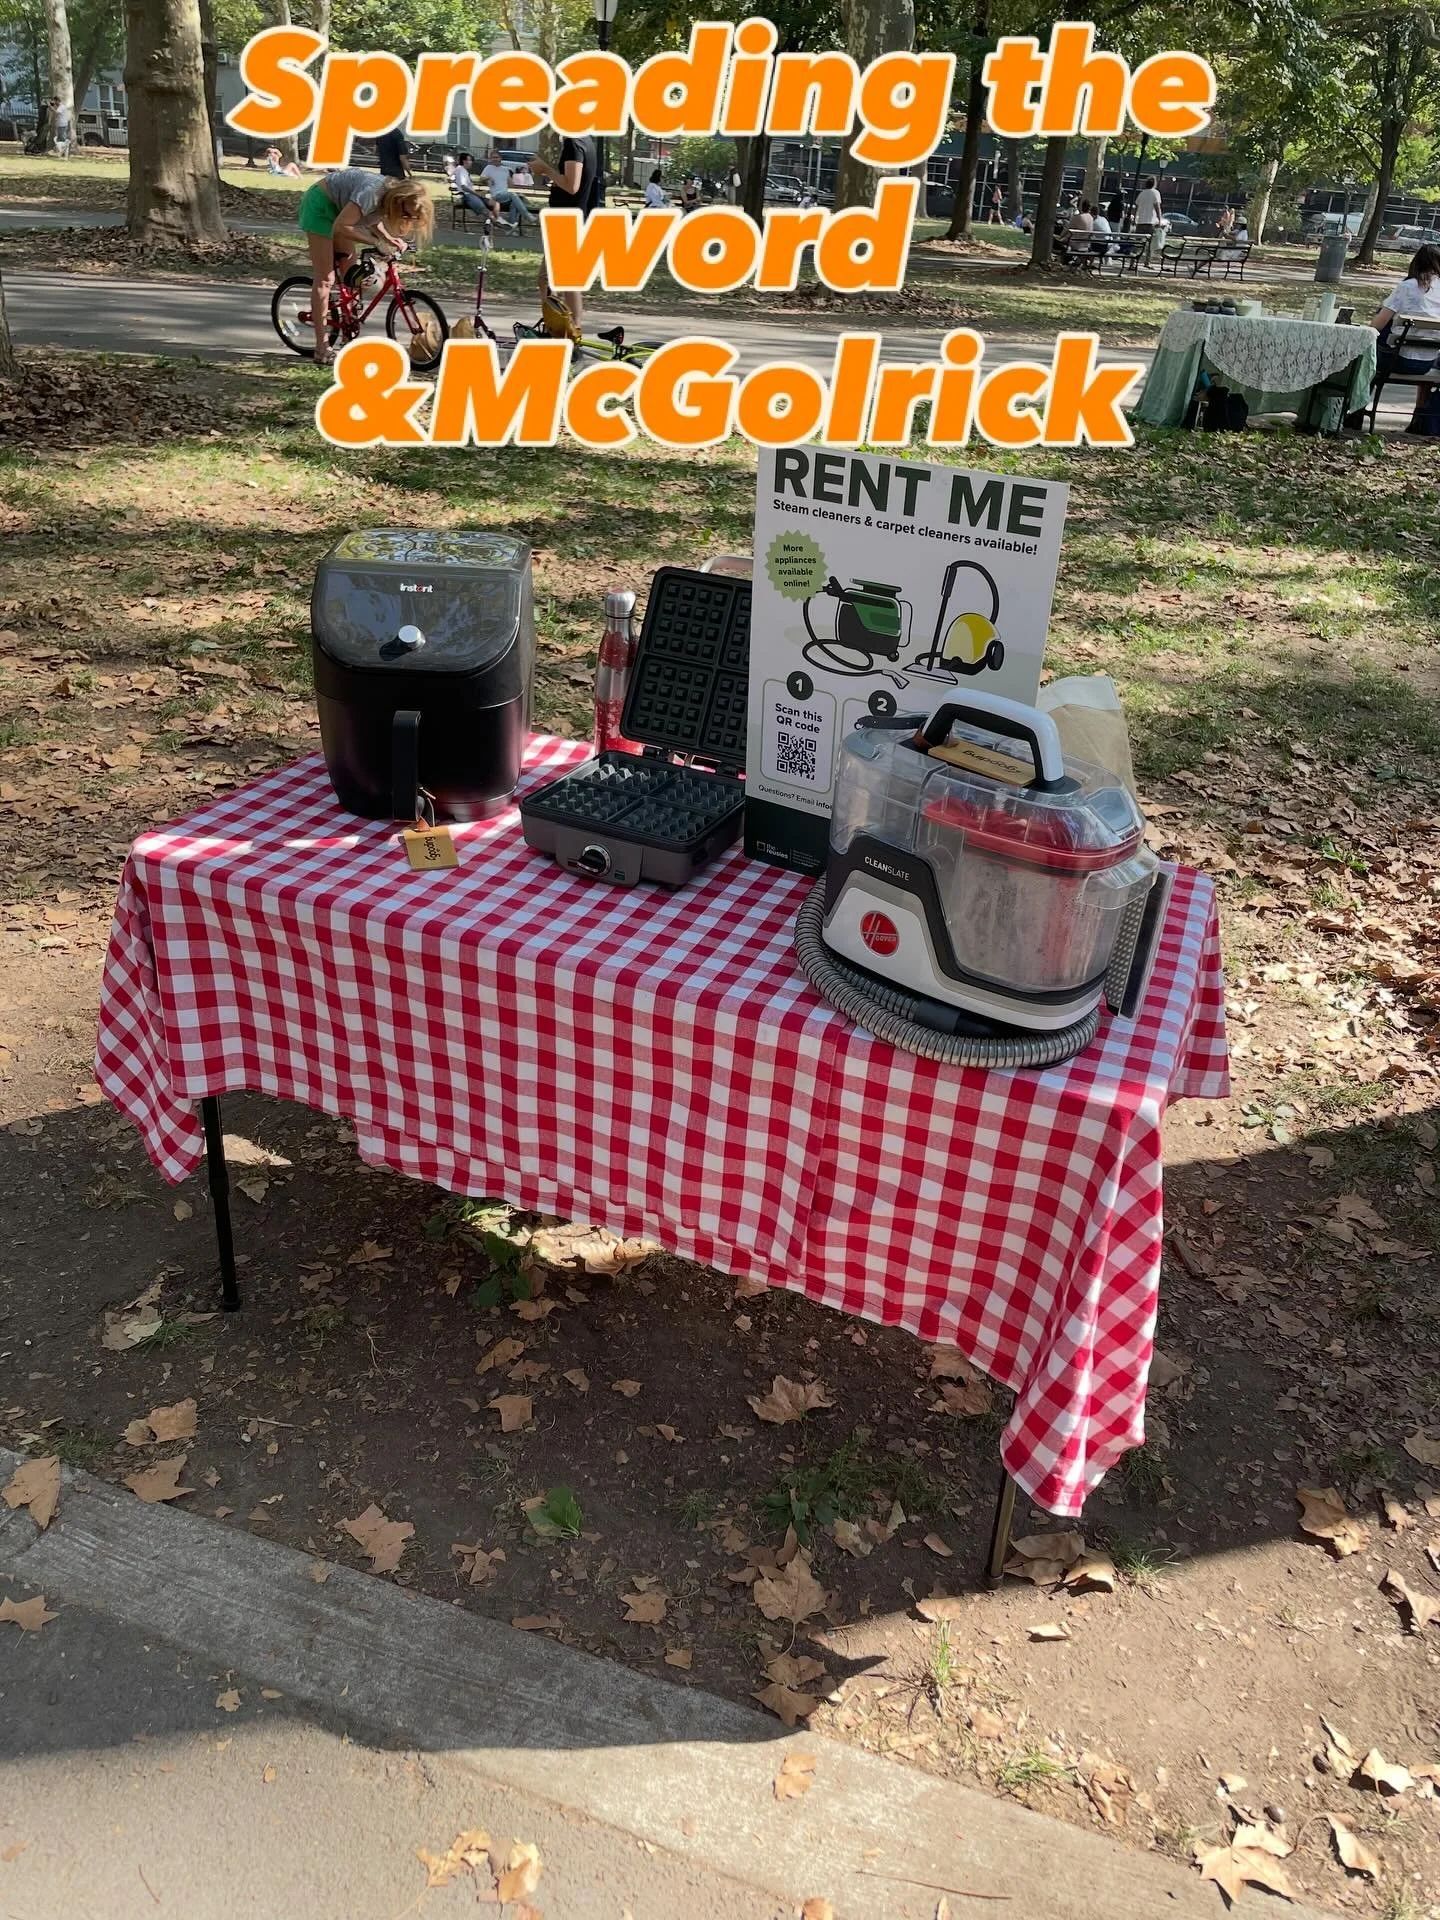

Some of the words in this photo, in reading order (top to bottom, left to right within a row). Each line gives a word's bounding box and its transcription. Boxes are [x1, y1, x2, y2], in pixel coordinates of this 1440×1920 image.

[774, 448, 932, 517] RENT
[947, 474, 1048, 538] ME
[773, 499, 809, 516] Steam
[812, 507, 861, 525] cleaners
[864, 515, 873, 527] &
[876, 520, 915, 535] carpet
[918, 526, 971, 544] cleaners
[974, 537, 1038, 555] available!
[783, 544, 804, 552] More
[774, 556, 817, 565] appliances
[778, 567, 814, 576] available
[783, 580, 810, 588] online!
[795, 678, 803, 692] 1
[775, 703, 800, 717] Scan
[803, 710, 823, 723] this
[876, 697, 888, 712] 2
[776, 715, 793, 727] QR
[795, 721, 820, 734] code
[758, 784, 795, 800] Questions?
[796, 795, 815, 806] Email
[864, 856, 910, 881] CLEANSLATE
